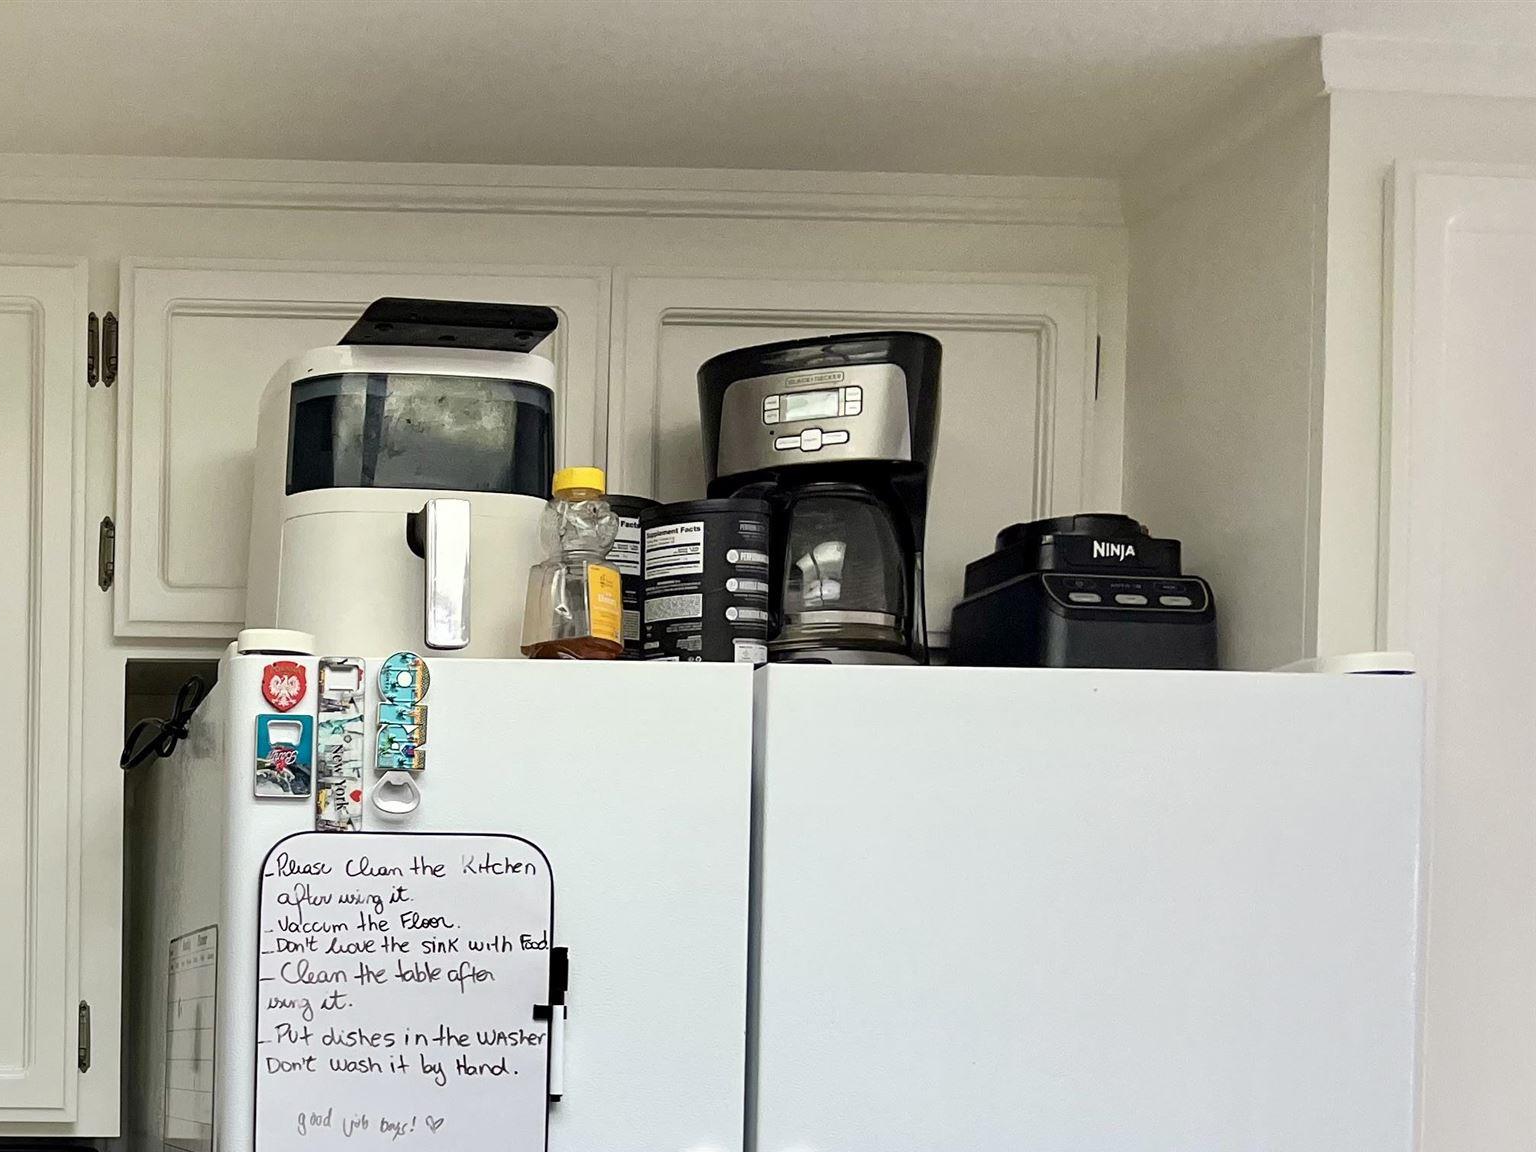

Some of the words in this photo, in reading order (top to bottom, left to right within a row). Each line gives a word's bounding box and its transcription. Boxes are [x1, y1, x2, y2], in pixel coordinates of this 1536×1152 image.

[680, 526, 701, 534] Facts
[1093, 540, 1136, 561] NINJA
[331, 744, 344, 773] New
[335, 779, 349, 812] York
[410, 856, 446, 877] the
[277, 883, 332, 925] after
[357, 911, 390, 931] the
[380, 936, 410, 953] the
[421, 936, 459, 954] sink
[468, 936, 512, 952] with
[354, 961, 388, 985] the
[394, 958, 441, 983] table
[447, 960, 495, 994] after
[322, 1026, 395, 1047] dishes
[404, 1027, 428, 1046] in
[432, 1024, 470, 1047] the
[266, 1055, 317, 1074] Don't
[390, 1053, 410, 1074] it
[420, 1053, 447, 1086] by
[298, 1107, 332, 1136] good
